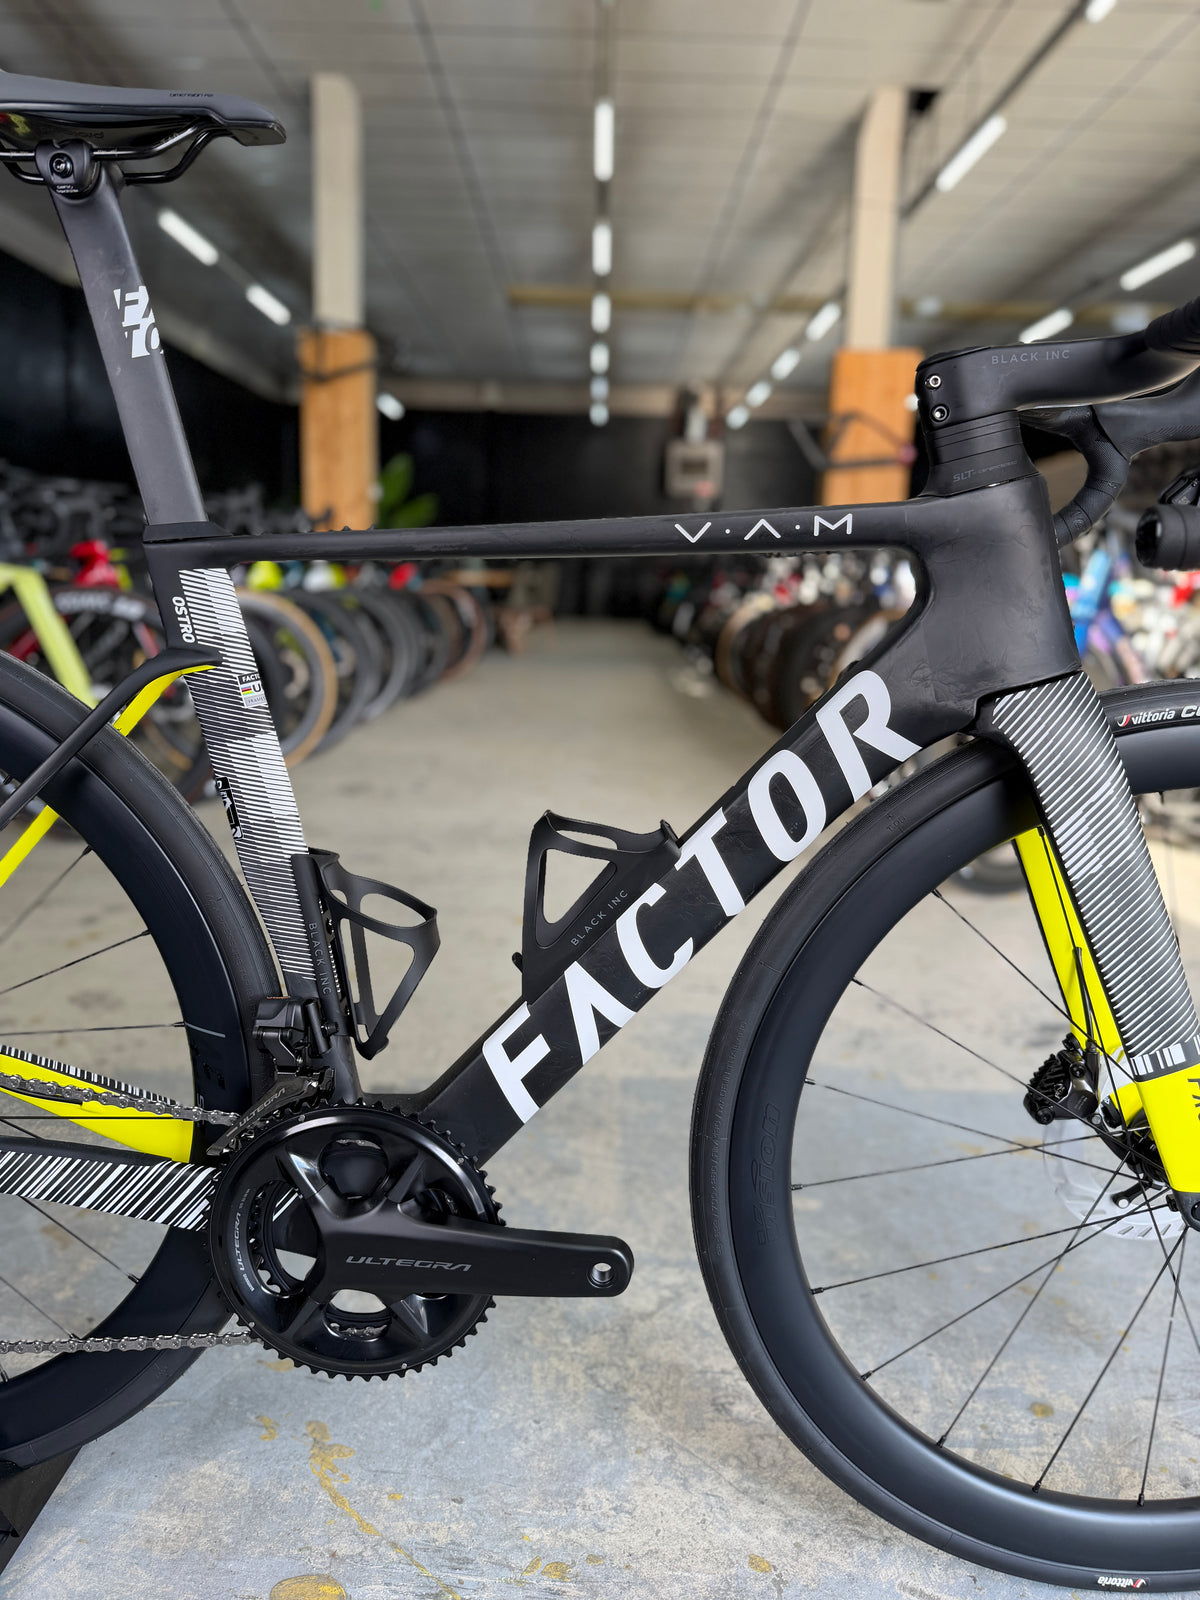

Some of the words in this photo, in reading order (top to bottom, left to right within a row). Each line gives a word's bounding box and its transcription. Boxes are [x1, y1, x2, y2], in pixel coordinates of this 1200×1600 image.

[991, 352, 1040, 365] BLACK
[1046, 349, 1071, 360] INC
[172, 596, 195, 644] OSTRO
[1131, 708, 1176, 725] vittoria
[482, 670, 922, 1124] FACTOR
[570, 911, 607, 946] BLACK
[607, 890, 628, 910] INC
[308, 922, 323, 966] BLACK
[319, 970, 332, 995] INC
[240, 1087, 286, 1127] ULTEGRA
[234, 1212, 245, 1271] ULTEGRA
[345, 1255, 473, 1272] ULTEGRA
[1097, 1576, 1134, 1588] vittoria
